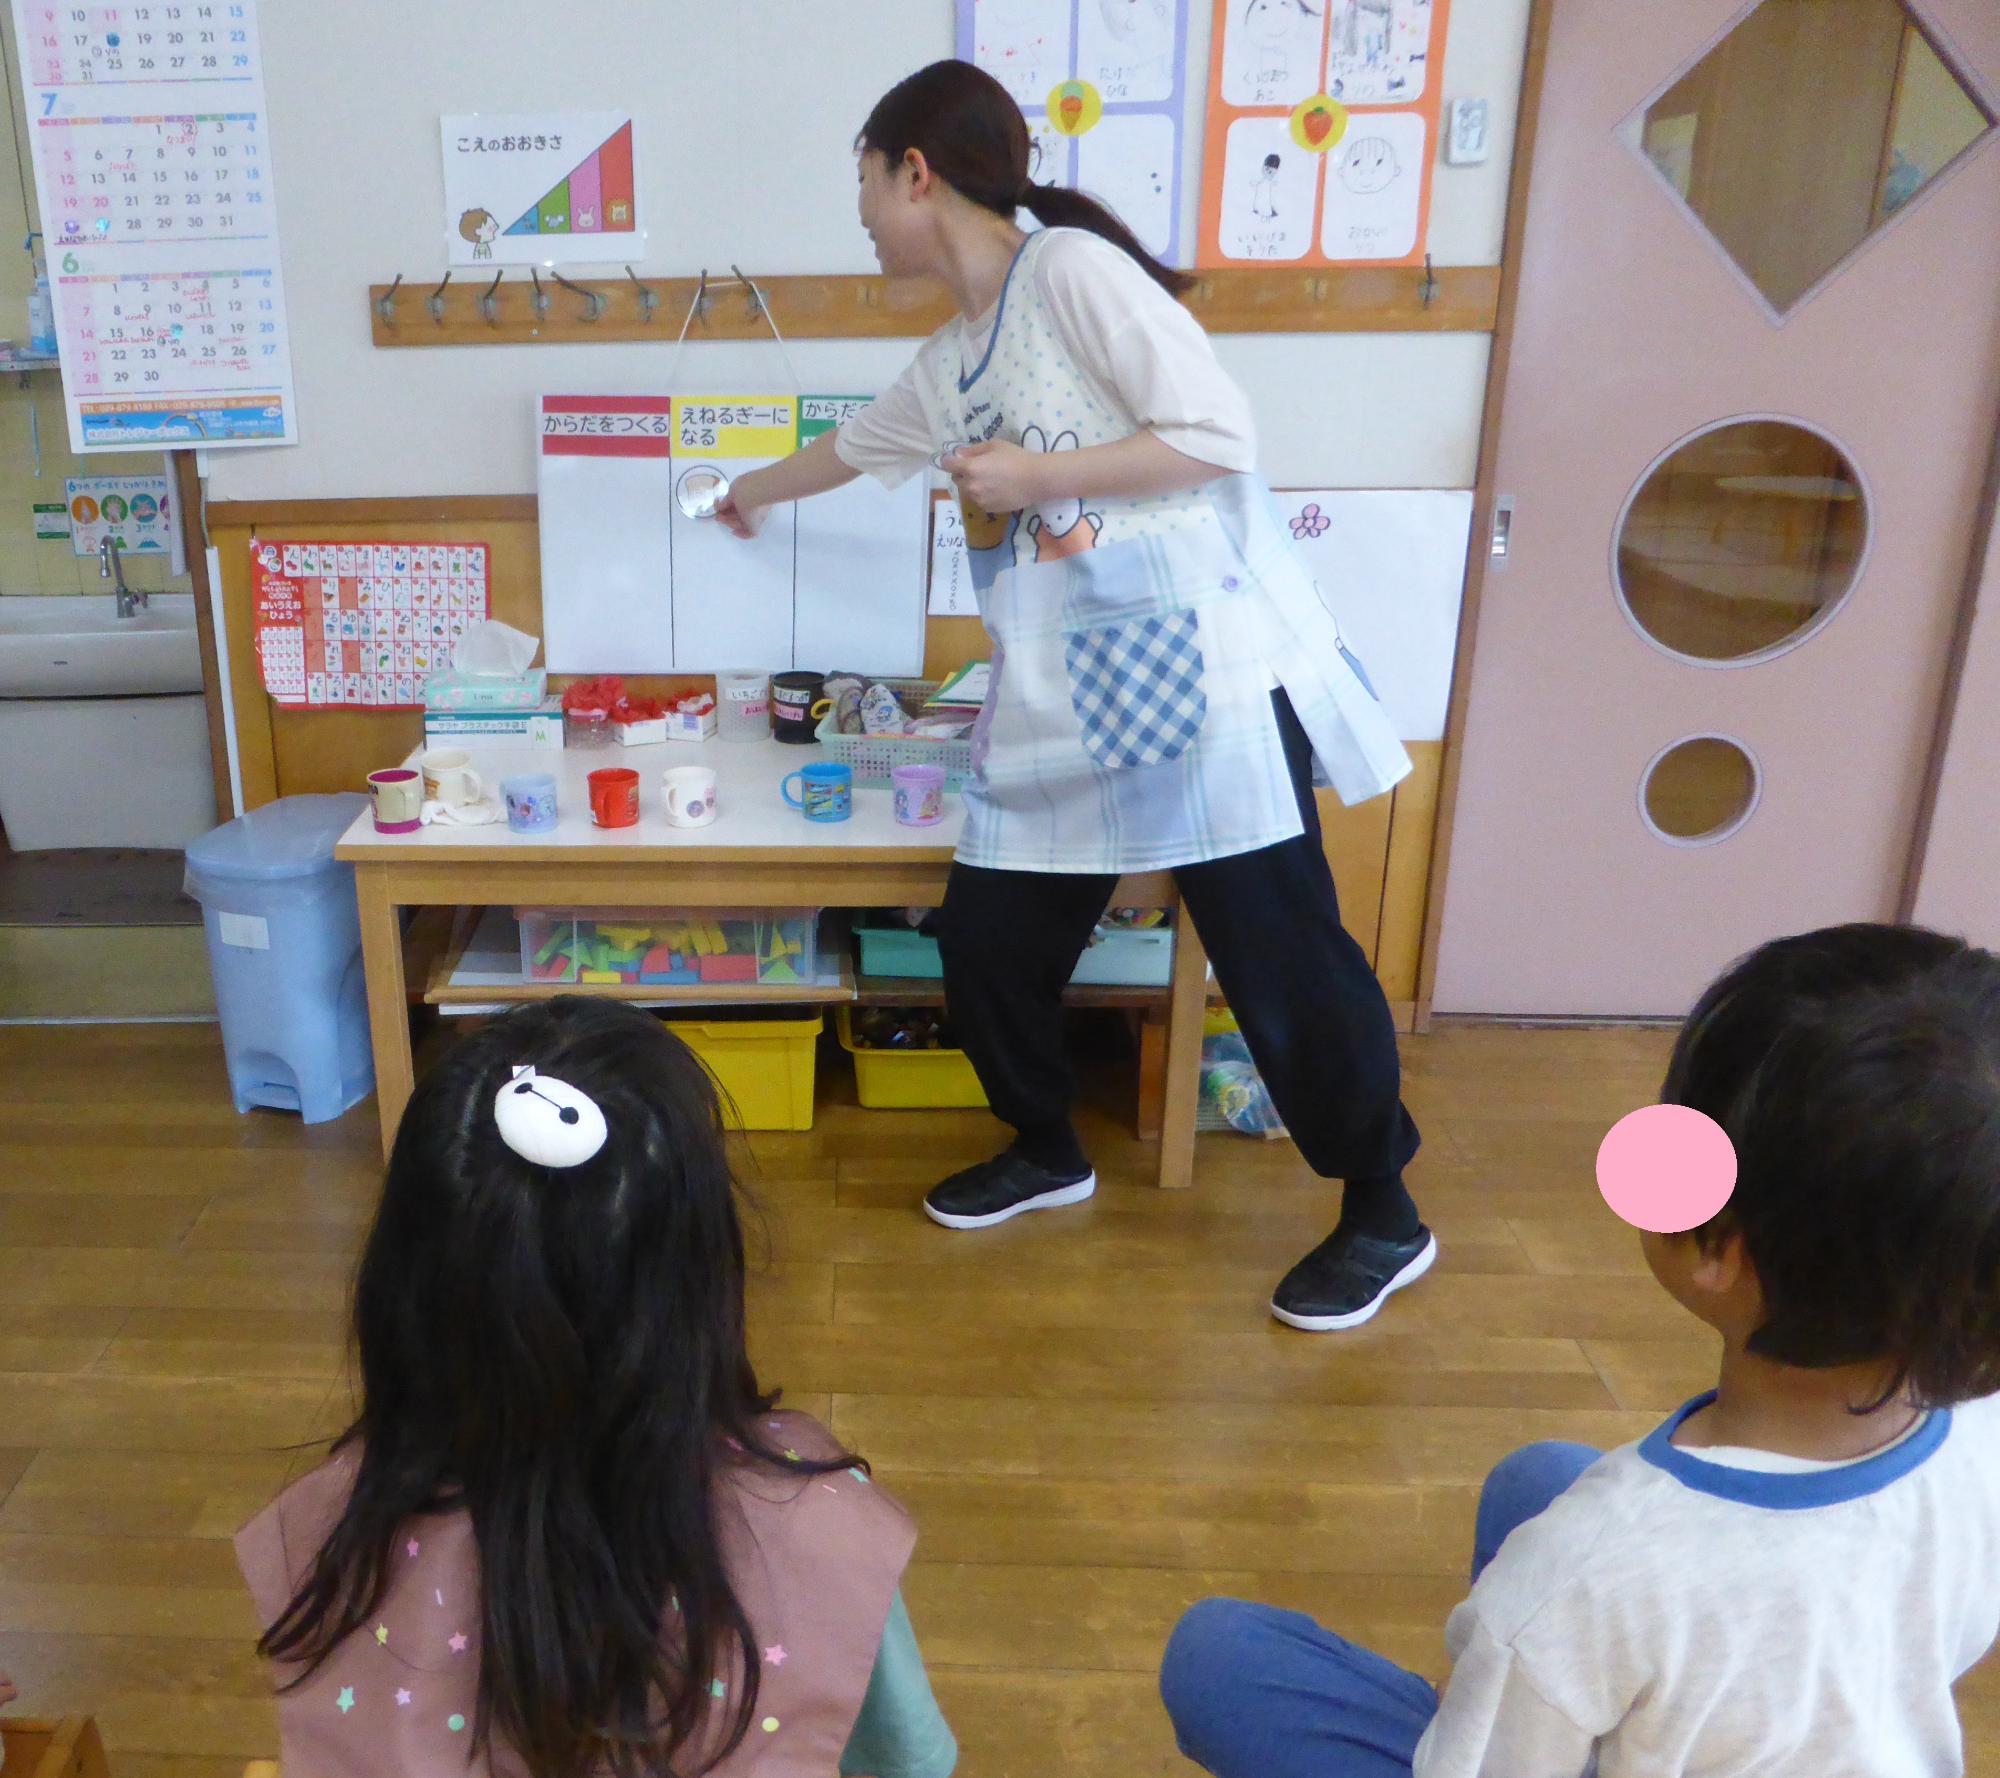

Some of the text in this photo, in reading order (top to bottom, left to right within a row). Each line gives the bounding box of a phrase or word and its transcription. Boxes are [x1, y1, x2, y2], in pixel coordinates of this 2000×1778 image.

[72, 11, 85, 21] 10
[105, 10, 117, 20] 11
[135, 9, 148, 20] 12
[167, 8, 180, 19] 13
[198, 7, 211, 18] 14
[230, 7, 242, 17] 15
[43, 31, 245, 47] 16 17 19 20 21 22
[78, 58, 93, 69] 24
[107, 59, 122, 69] 25
[139, 58, 154, 69] 26
[170, 57, 185, 68] 27
[202, 56, 216, 67] 28
[233, 55, 247, 66] 29
[81, 70, 94, 81] 31
[41, 93, 58, 115] 7
[156, 124, 161, 135] 1
[186, 123, 194, 134] 2
[216, 123, 224, 134] 3
[457, 135, 562, 152] こえのおおきさ
[63, 150, 72, 161] 5
[94, 150, 103, 160] 6
[125, 149, 133, 159] 7
[156, 148, 164, 158] 8
[187, 147, 196, 157] 9
[213, 146, 226, 157] 10
[61, 174, 73, 185] 12
[92, 173, 105, 184] 13
[123, 172, 135, 183] 14
[154, 172, 167, 182] 15
[185, 171, 198, 181] 16
[215, 170, 228, 180] 17
[64, 192, 261, 208] 19 20 21 22 23 24 25
[127, 216, 233, 230] 28 29 30 31
[62, 253, 79, 274] 6
[113, 283, 118, 293] 1
[141, 282, 149, 292] 2
[171, 281, 179, 291] 3
[232, 278, 240, 289] 5
[262, 277, 270, 288] 6
[82, 300, 272, 317] 7 8 9 10 11 12 13
[81, 322, 274, 339] 14 15 16 18 19 20
[83, 344, 276, 361] 21 22 23 24 25 26 27
[84, 371, 159, 384] 28 29 30
[680, 406, 789, 426] えねるぎーに
[805, 402, 869, 419] からだ
[544, 415, 668, 433] からだをつくる
[680, 428, 716, 446] なる
[536, 731, 545, 741] M
